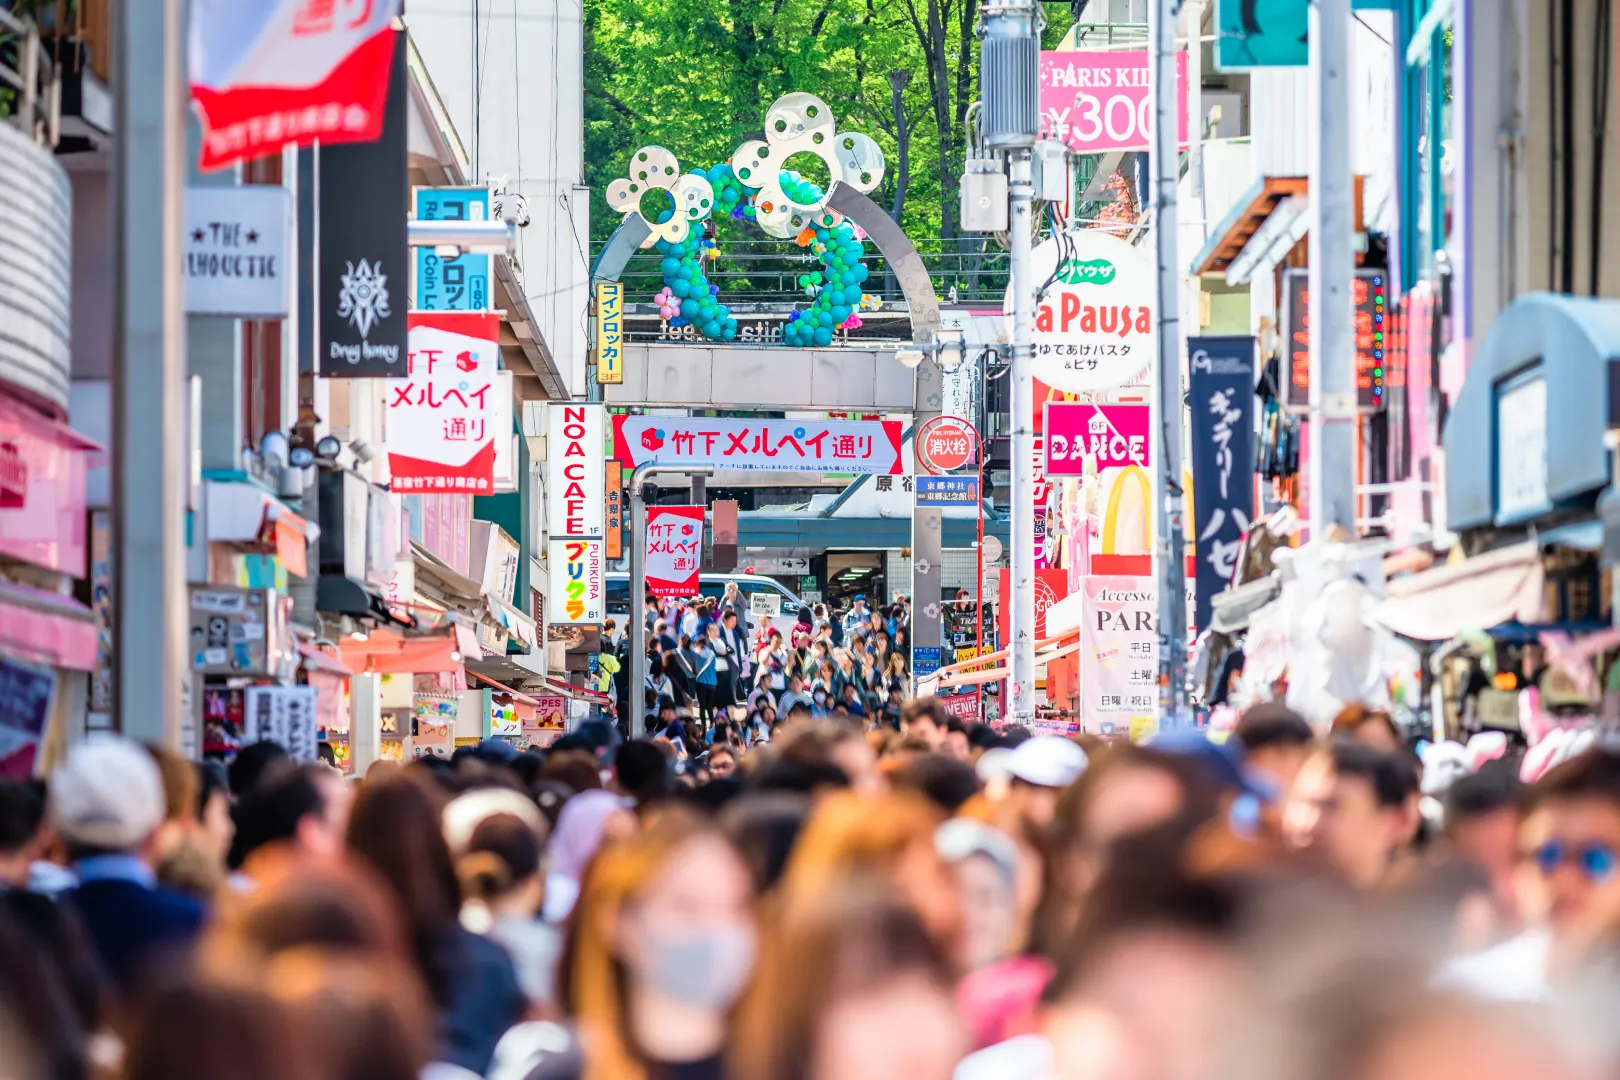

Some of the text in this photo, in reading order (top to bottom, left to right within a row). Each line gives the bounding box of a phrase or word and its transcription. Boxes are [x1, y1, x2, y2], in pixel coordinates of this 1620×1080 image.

[1051, 61, 1112, 87] PARIS
[208, 222, 241, 248] THE
[1060, 291, 1151, 338] Pausa
[602, 285, 621, 371] コインロッカー
[330, 342, 362, 364] Drug
[600, 373, 620, 381] 3F
[390, 380, 491, 409] メルペイ
[443, 417, 485, 442] 通り
[1091, 421, 1106, 431] 6F
[671, 427, 872, 459] 竹下メルペイ通り
[929, 437, 967, 456] 消火栓
[1050, 434, 1145, 461] DANCE
[563, 406, 587, 535] NOA CAFE
[926, 491, 967, 501] 東郷記念館
[927, 481, 965, 491] 東郷神社
[589, 526, 599, 535] 1F
[649, 524, 676, 537] 竹下
[648, 539, 699, 554] メルペイ
[590, 544, 599, 600] PURIKURA
[673, 558, 695, 571] 通り
[565, 541, 588, 621] プリクラ
[588, 610, 599, 619] B1
[1130, 642, 1151, 653] 平日
[1130, 669, 1152, 680] 土曜
